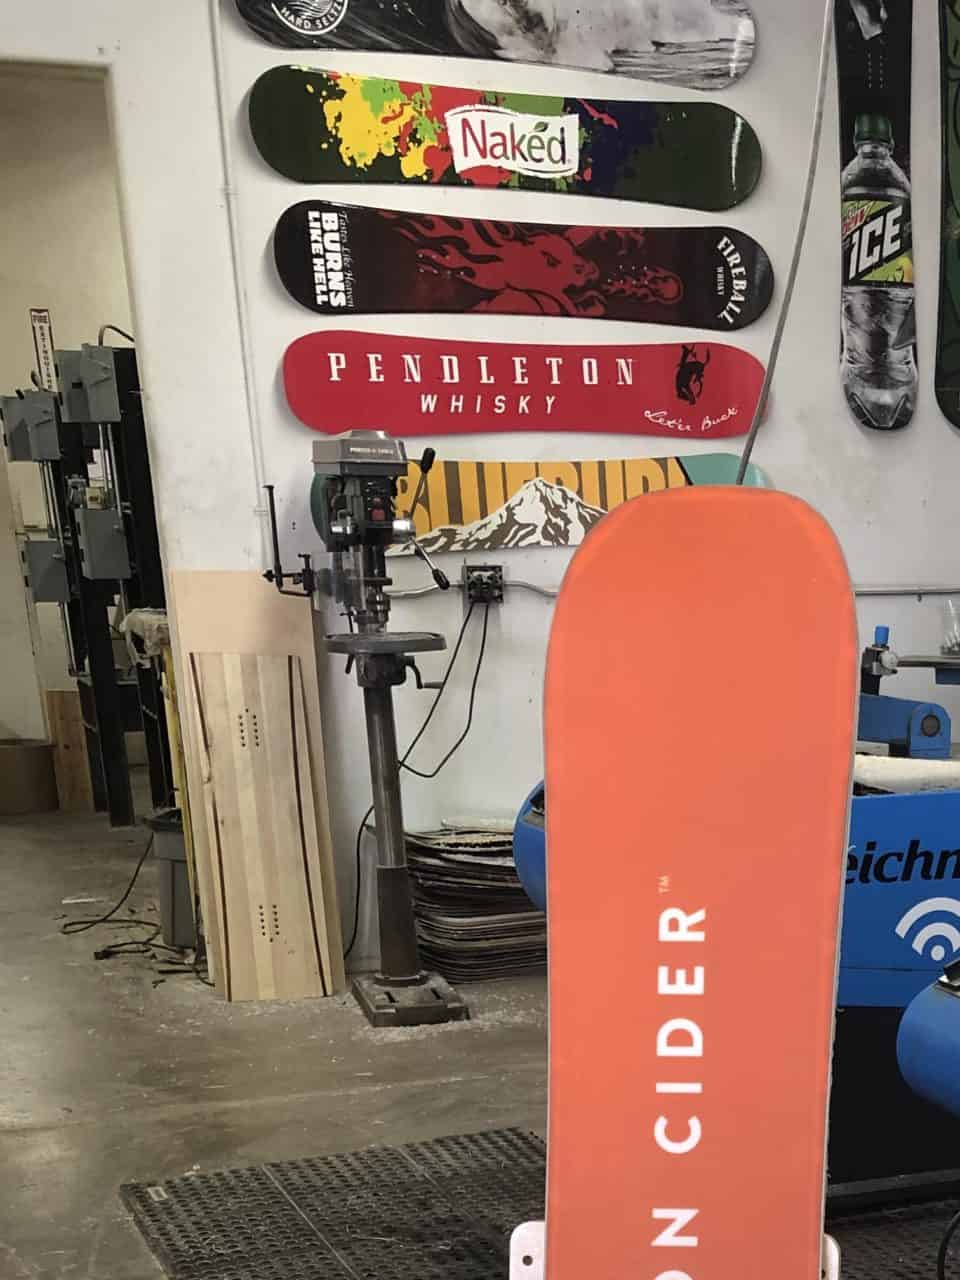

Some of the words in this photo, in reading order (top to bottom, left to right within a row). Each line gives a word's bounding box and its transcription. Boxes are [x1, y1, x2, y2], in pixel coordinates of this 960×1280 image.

[281, 7, 312, 29] HARD
[315, 0, 342, 28] SELTZ
[308, 210, 324, 256] LIKE
[849, 205, 903, 281] ICE
[313, 258, 329, 305] HELL
[321, 212, 347, 307] BURNS
[717, 236, 747, 324] FIREBALL
[327, 352, 634, 385] PENDLETON
[421, 394, 556, 415] WHISKY
[654, 907, 707, 1153] CIDER
